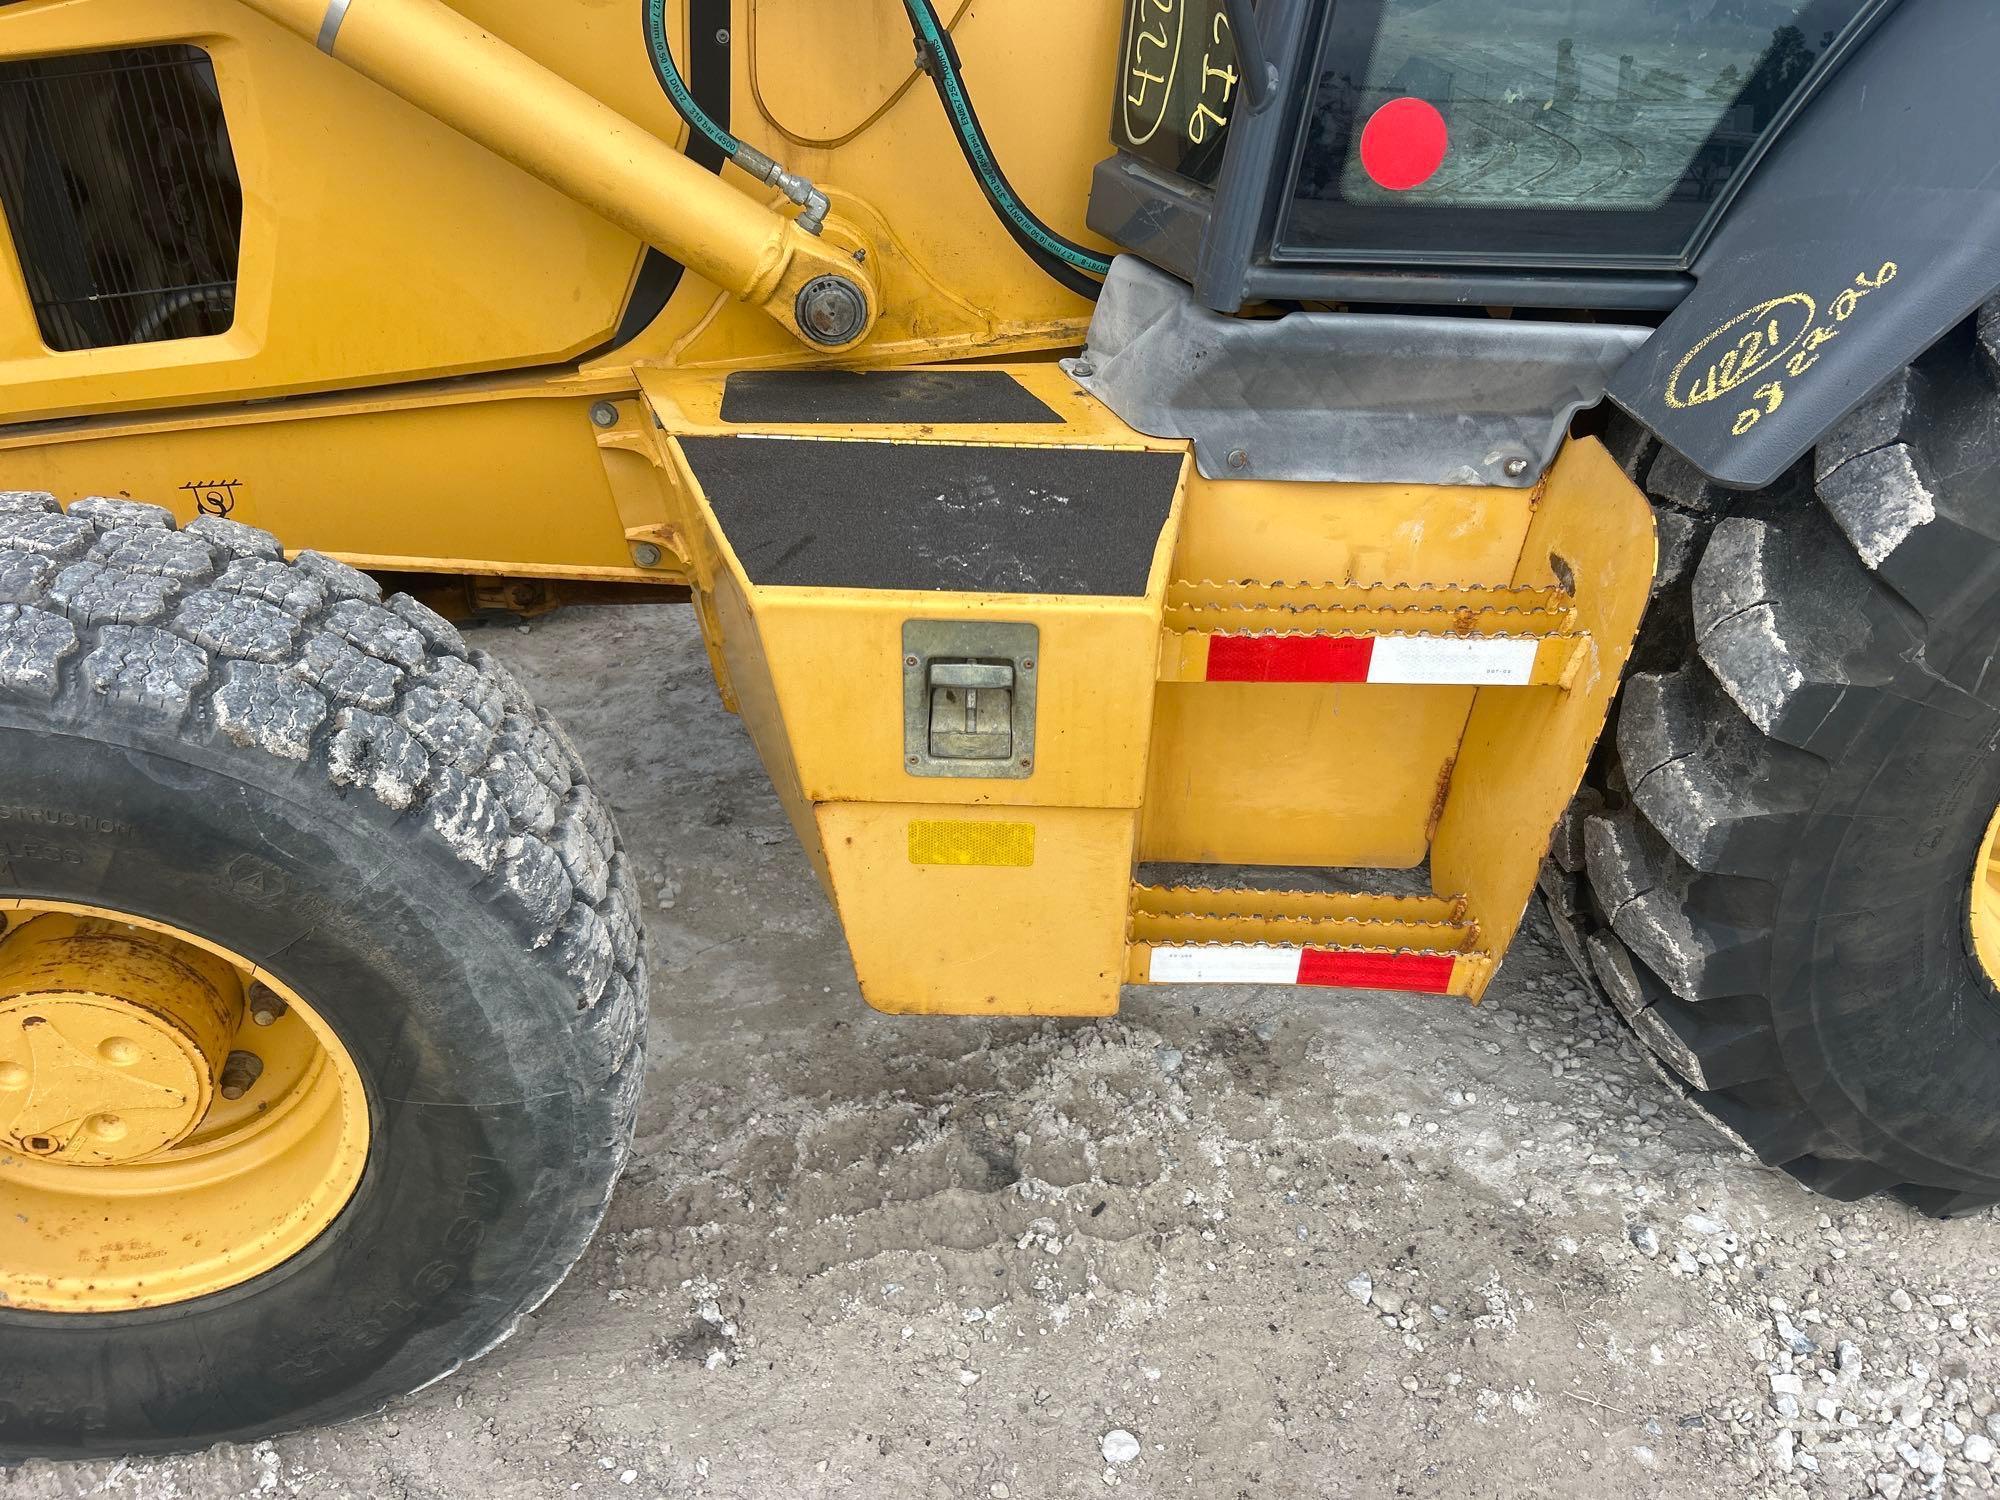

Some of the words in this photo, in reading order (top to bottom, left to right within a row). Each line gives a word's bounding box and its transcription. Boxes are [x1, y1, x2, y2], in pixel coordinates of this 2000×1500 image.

[652, 20, 660, 39] mm
[655, 41, 668, 64] (0.50
[663, 65, 673, 78] in)
[669, 78, 687, 102] DN12
[689, 107, 702, 123] 310
[955, 99, 969, 126] EN857
[701, 120, 716, 135] bar
[714, 132, 736, 152] (4500
[968, 133, 980, 148] psi)
[1006, 203, 1022, 223] DN12
[1688, 319, 1779, 403] 4221
